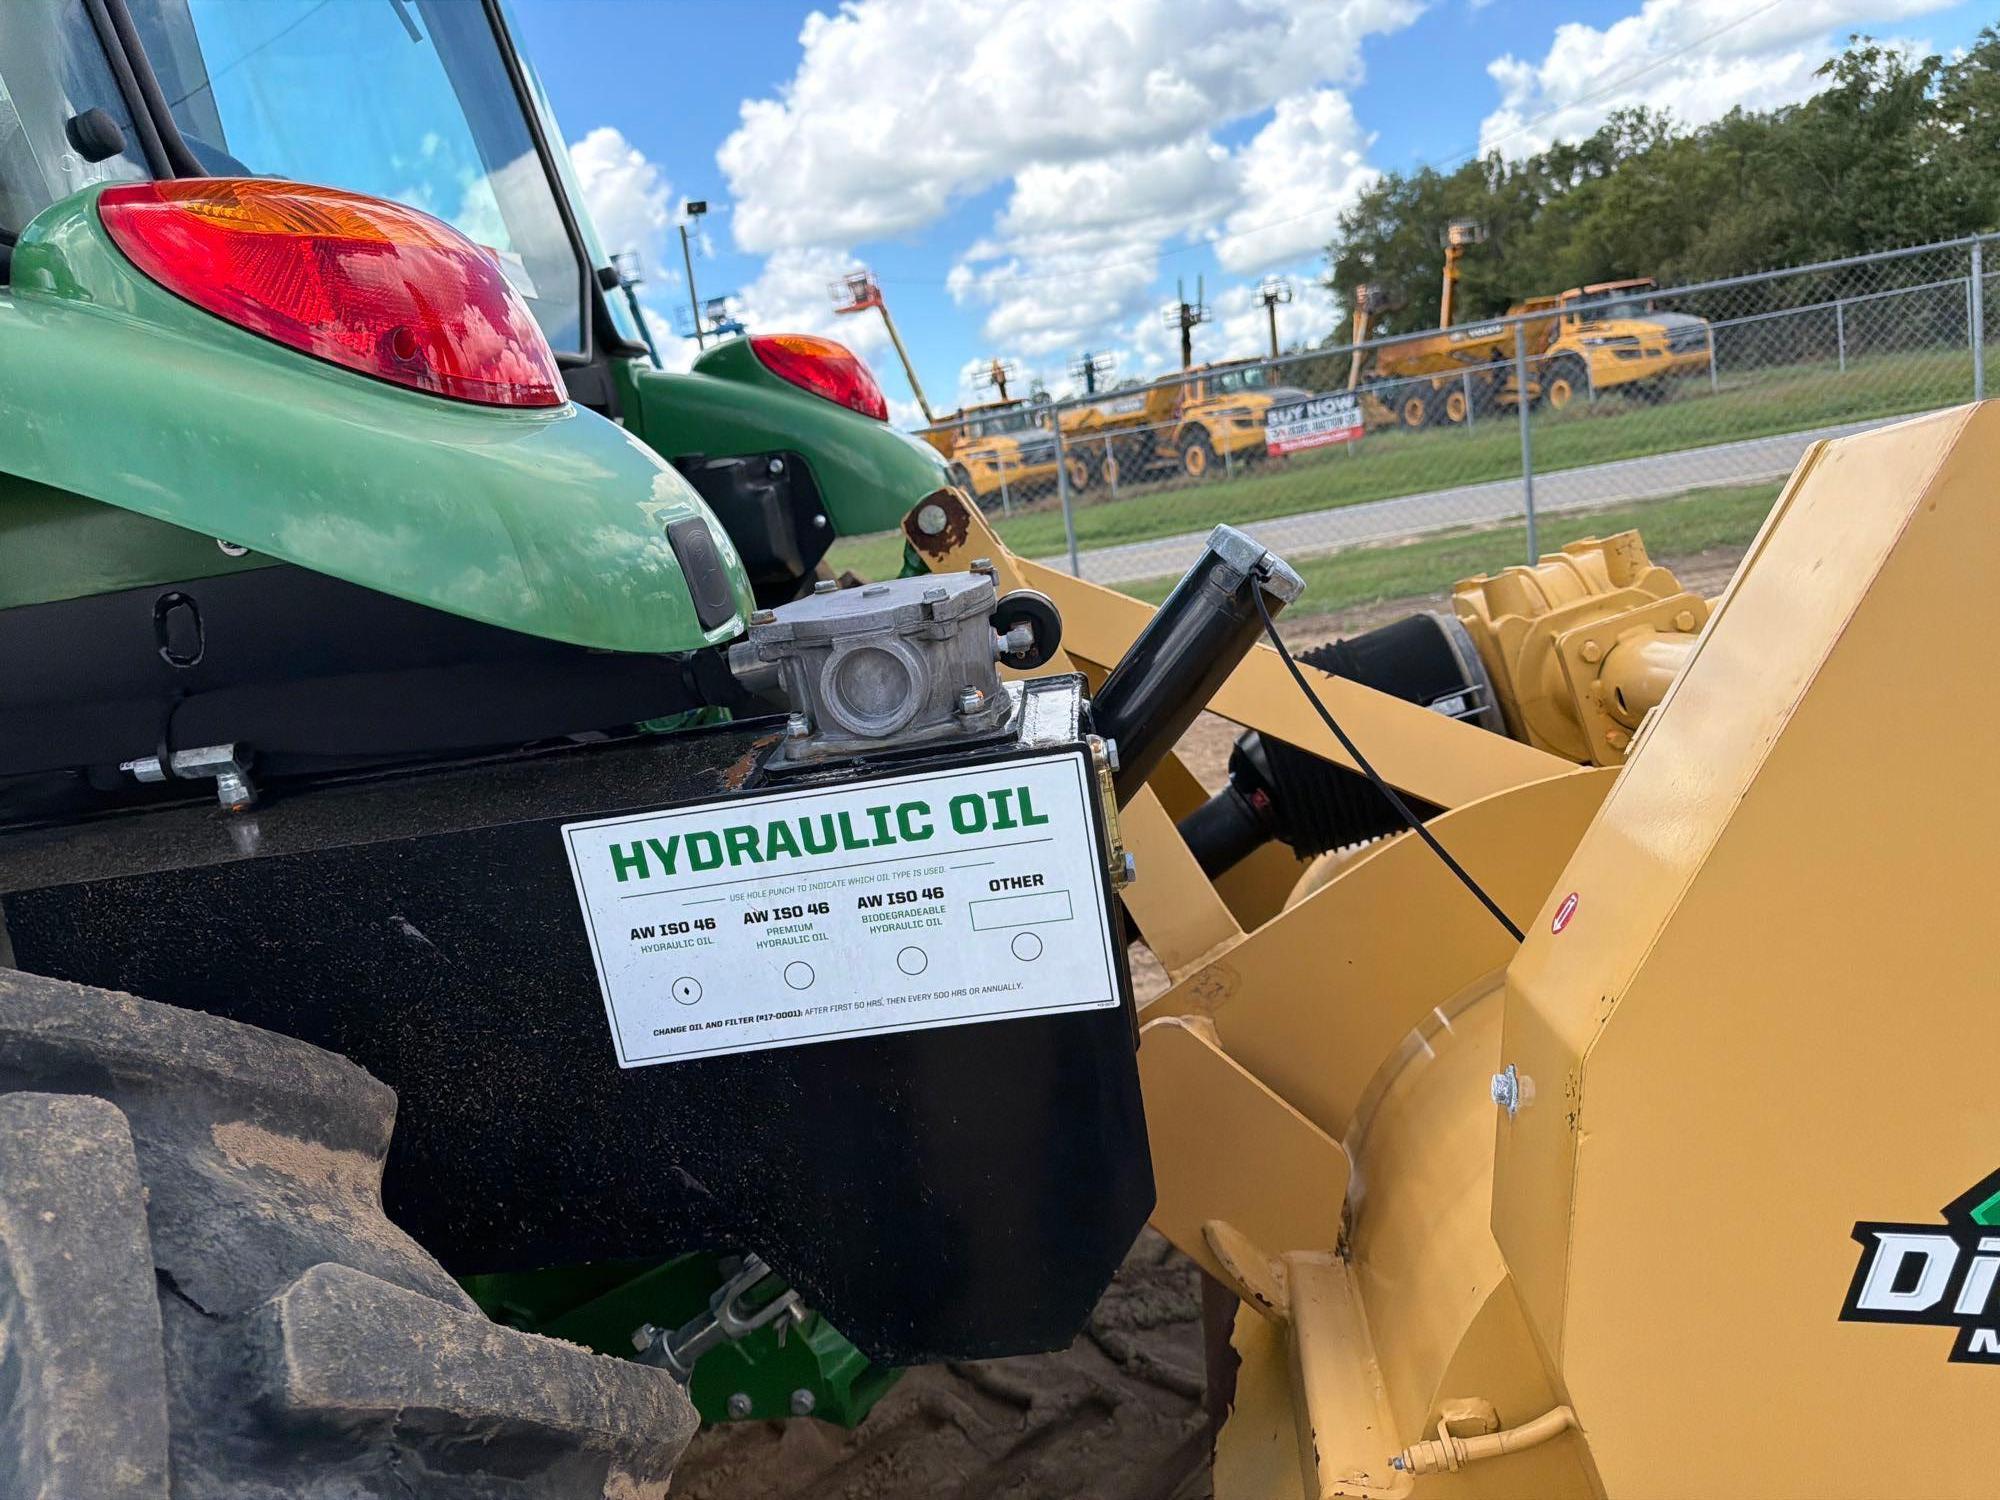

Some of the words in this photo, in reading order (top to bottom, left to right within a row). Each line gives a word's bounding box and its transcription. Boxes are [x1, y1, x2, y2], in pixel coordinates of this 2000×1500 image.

[1268, 403, 1304, 426] BUY
[1307, 395, 1354, 418] NOW
[609, 800, 934, 881] HYDRAULIC
[949, 786, 1049, 834] OIL
[729, 893, 745, 902] USE
[747, 889, 767, 899] HOLE
[768, 885, 795, 896] PUNCH
[797, 882, 807, 891] TO
[809, 879, 846, 891] INDICATE
[848, 876, 875, 885] WHICH
[876, 873, 890, 881] OIL
[891, 870, 911, 880] TYPE
[913, 869, 922, 877] IS
[989, 874, 1044, 892] OTHER
[858, 895, 882, 909] AW
[886, 890, 918, 905] ISO
[922, 887, 944, 900] 46
[744, 908, 768, 924] AW
[772, 905, 803, 920] ISO
[807, 902, 829, 915] 46
[862, 905, 946, 923] BIODEGRADEABLE
[631, 926, 655, 940] AW
[659, 921, 690, 936] ISO
[694, 918, 716, 930] 46
[766, 922, 813, 936] PREMIUM
[870, 920, 924, 934] HYDRAULIC
[926, 917, 943, 927] OIL
[641, 939, 694, 954] HYDRAULIC
[696, 937, 715, 947] OIL
[756, 935, 810, 949] HYDRAULIC
[812, 933, 829, 941] OIL
[653, 1026, 687, 1036] CHANGE
[705, 1021, 723, 1029] AND
[725, 1016, 754, 1026] FILTER
[805, 1006, 829, 1016] AFTER
[830, 1003, 853, 1013] FIRST
[854, 1001, 865, 1009] 50
[886, 996, 906, 1006] THEN
[908, 992, 932, 1002] EVERY
[934, 991, 949, 999] 500
[951, 989, 967, 998] HRS
[969, 987, 980, 996] OR
